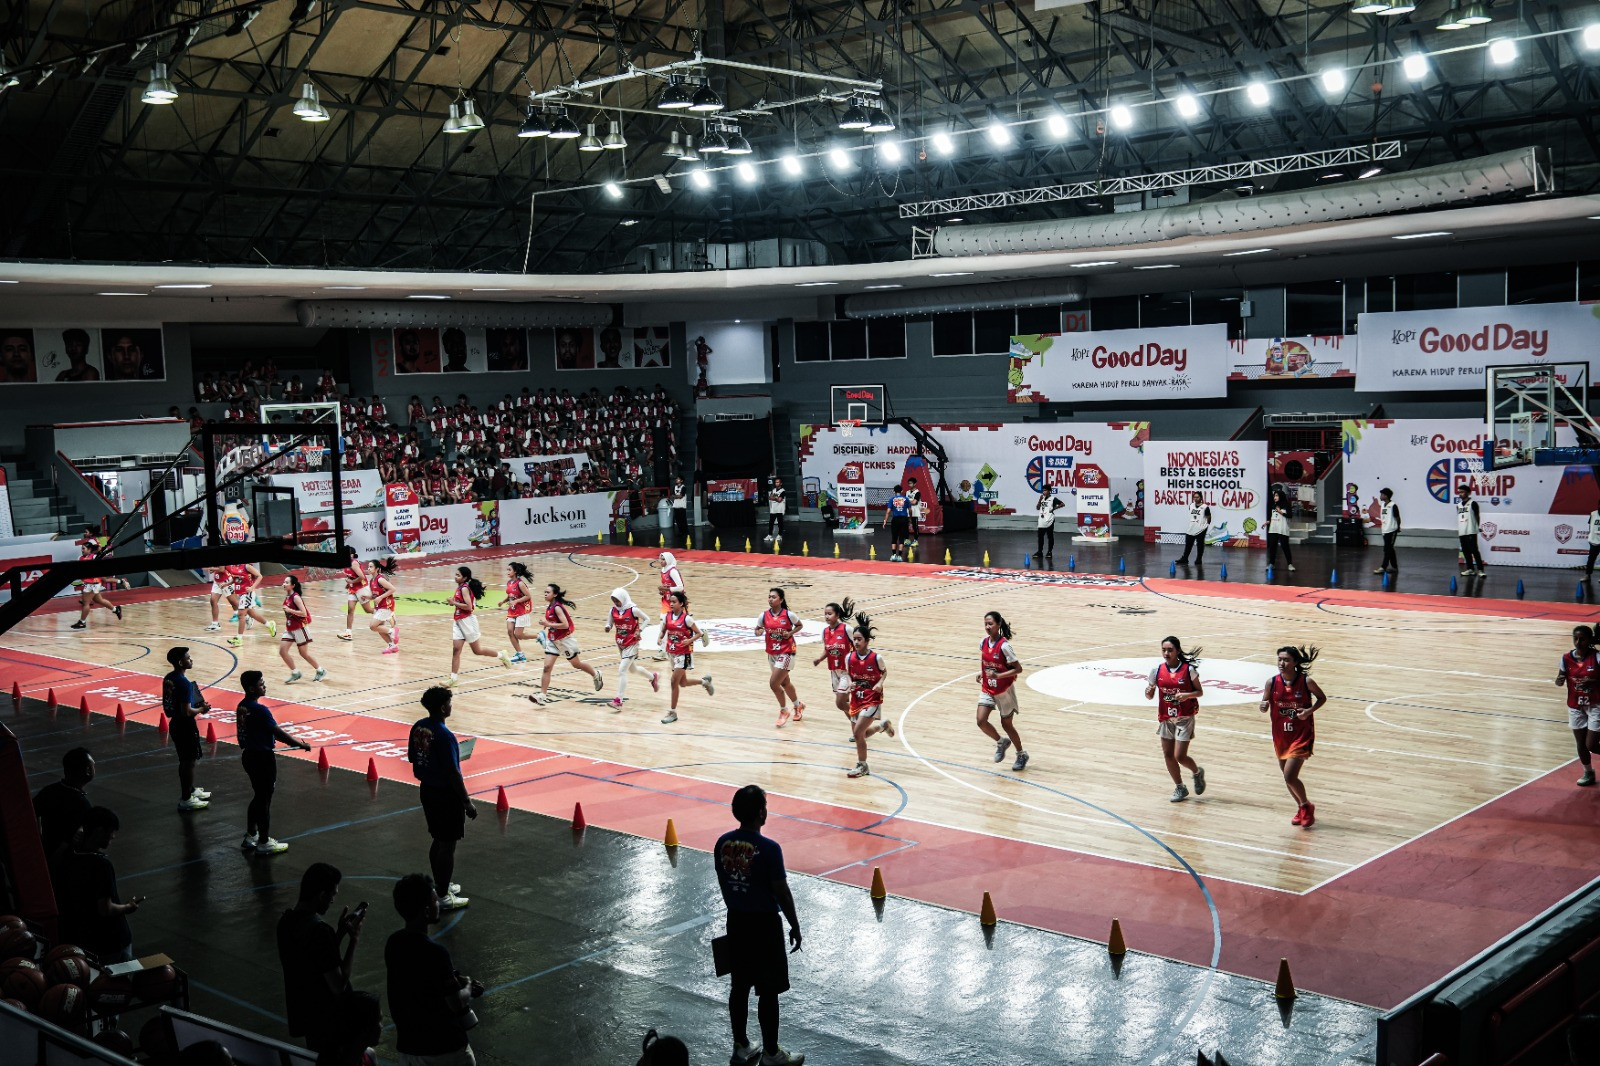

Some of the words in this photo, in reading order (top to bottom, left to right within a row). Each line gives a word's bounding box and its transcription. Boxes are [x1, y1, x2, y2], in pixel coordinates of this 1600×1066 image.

[1066, 314, 1086, 331] D1
[1419, 325, 1489, 353] Good
[1493, 323, 1548, 356] Day
[1092, 345, 1144, 368] Good
[1146, 343, 1187, 371] Day
[1392, 369, 1428, 377] KARENA
[1430, 368, 1454, 376] HIDUP
[1458, 367, 1484, 375] PERLU
[1100, 380, 1119, 388] HIDUP
[1120, 379, 1140, 387] PERLU
[1142, 379, 1167, 387] BANYAK
[833, 445, 875, 455] DISCIPLINE
[1028, 435, 1063, 451] Good
[1066, 435, 1092, 455] Day
[1430, 434, 1480, 453] Good
[1167, 451, 1239, 467] INDONESIA'S
[1160, 467, 1185, 477] BEST
[1188, 467, 1196, 477] &
[1198, 468, 1246, 478] BIGGEST
[1167, 479, 1194, 489] HIGH
[1197, 480, 1242, 490] SCHOOL
[1454, 475, 1515, 496] CAMP
[1221, 489, 1254, 509] CAMP
[419, 515, 448, 533] Day
[525, 506, 586, 526] Jackson
[1283, 722, 1294, 732] 16
